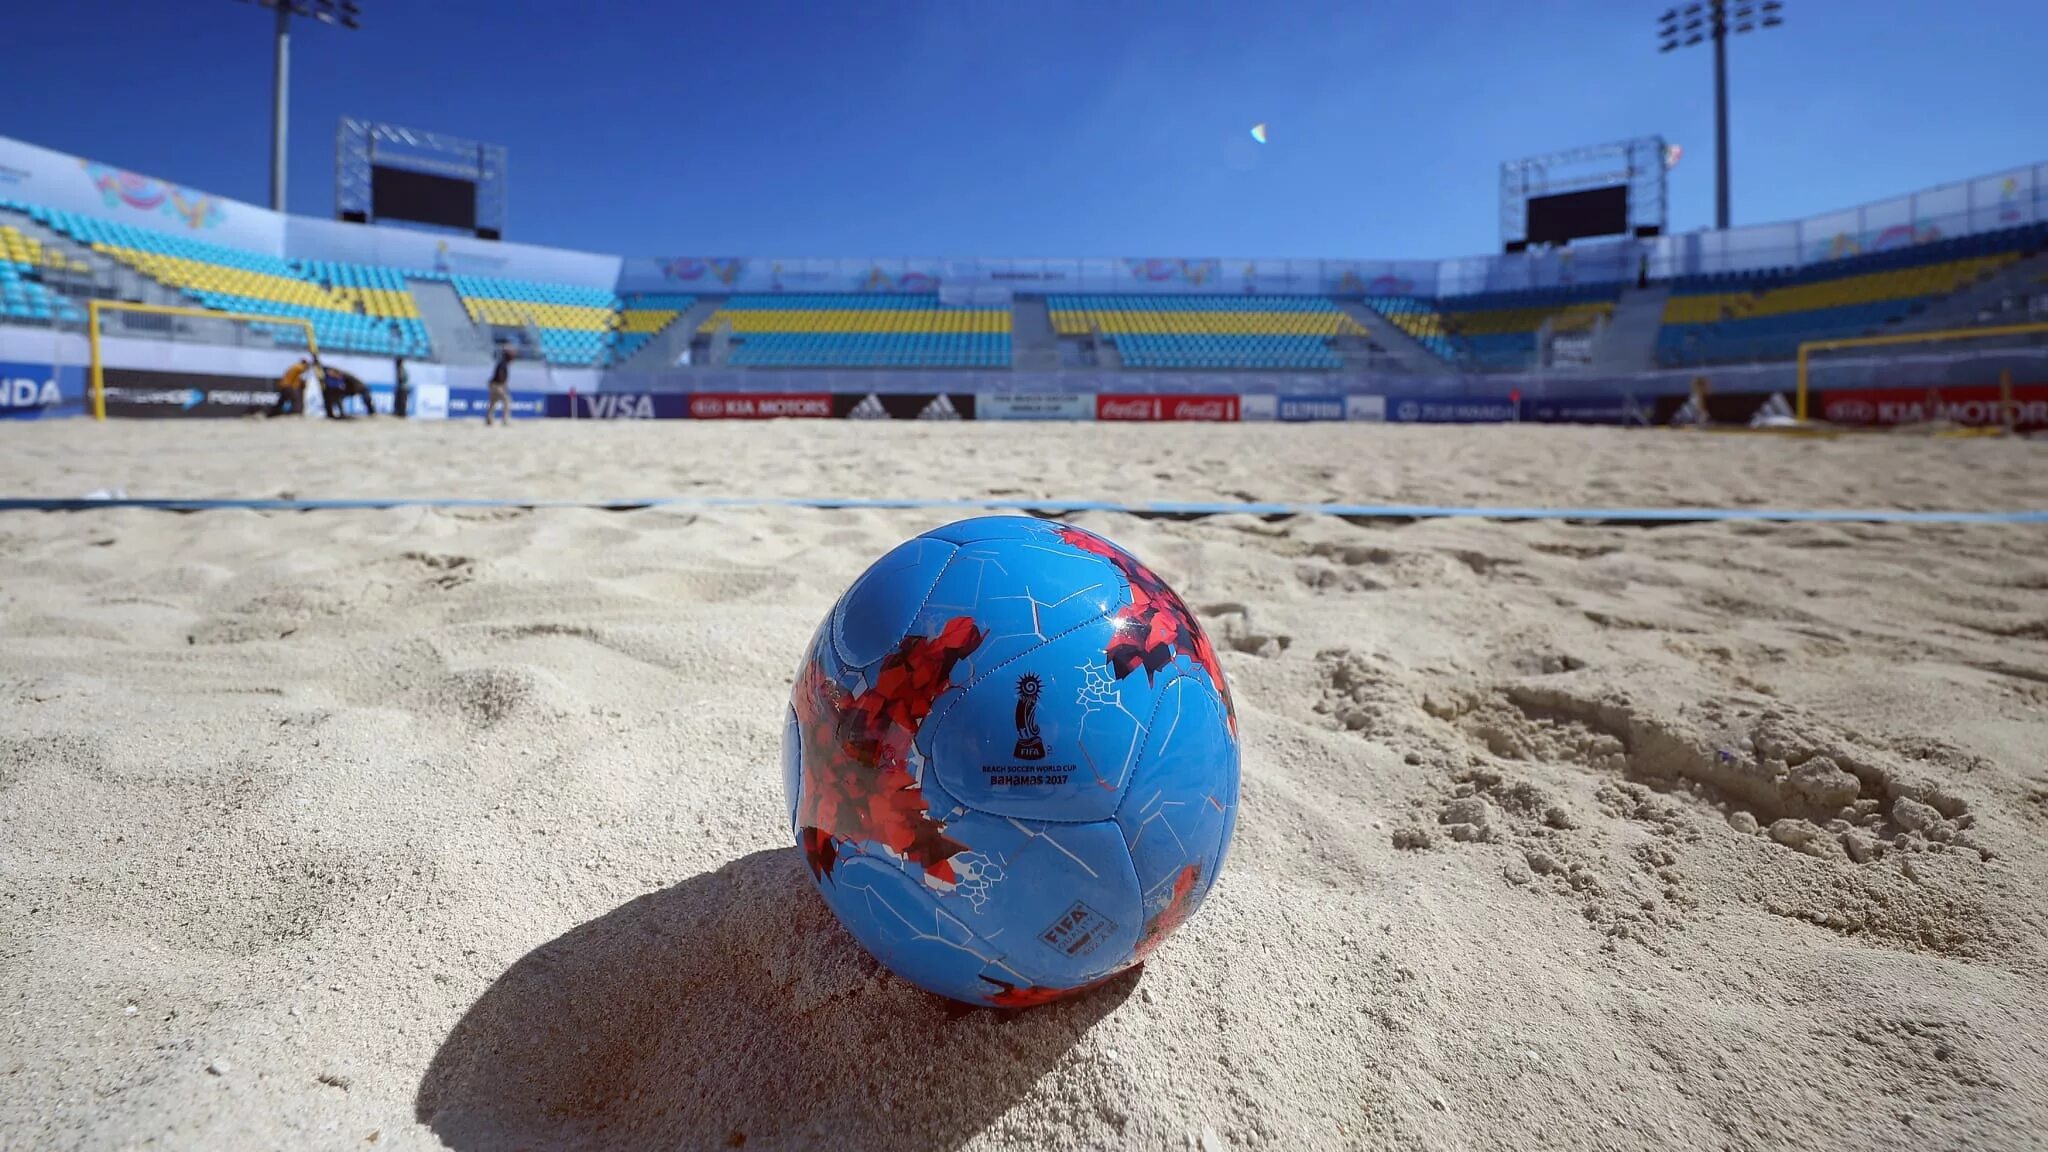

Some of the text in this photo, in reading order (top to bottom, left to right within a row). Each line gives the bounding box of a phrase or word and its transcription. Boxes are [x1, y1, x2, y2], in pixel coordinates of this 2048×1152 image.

[585, 394, 656, 418] VISA
[726, 400, 754, 414] KIA
[758, 400, 829, 415] MOTORS
[1020, 748, 1040, 756] FIFA
[982, 764, 1077, 773] BEACH SOCCER WORLD CUP
[1045, 775, 1068, 784] 2017
[1044, 910, 1088, 944] FIFA
